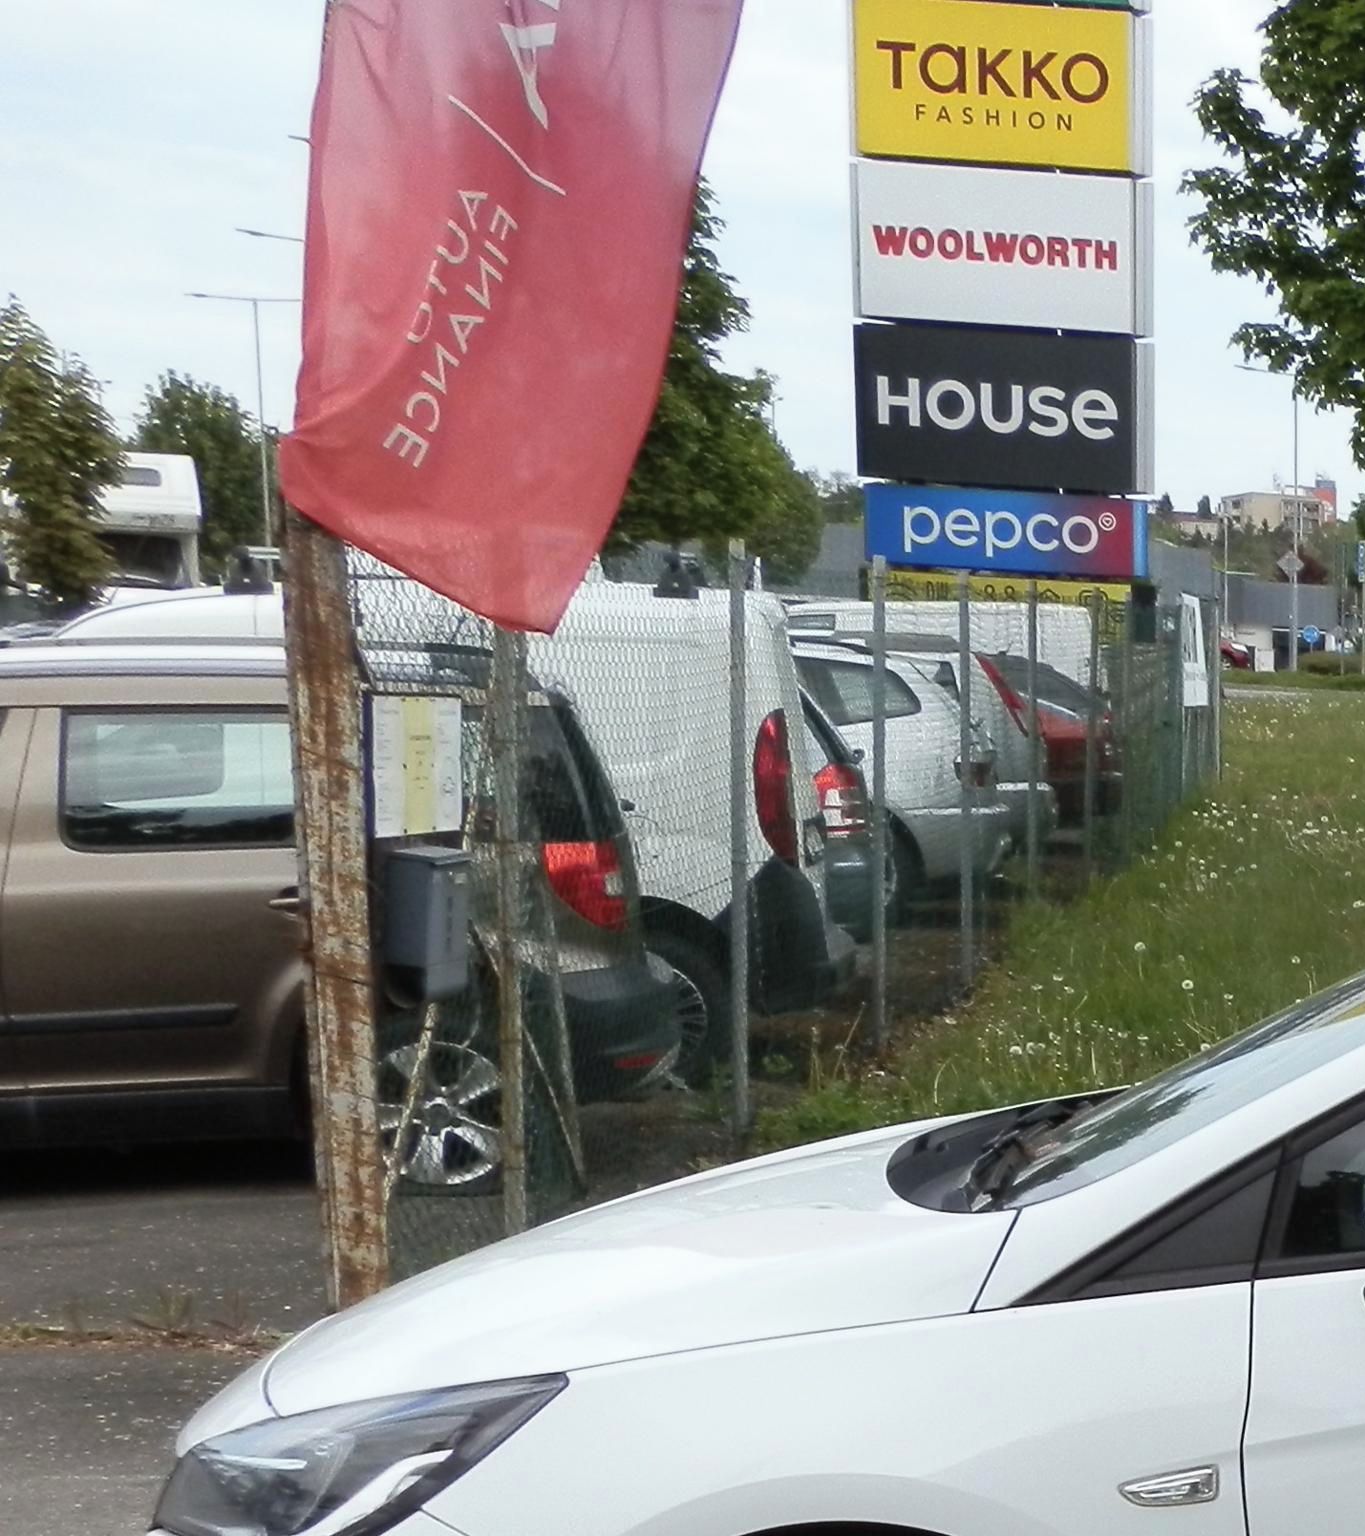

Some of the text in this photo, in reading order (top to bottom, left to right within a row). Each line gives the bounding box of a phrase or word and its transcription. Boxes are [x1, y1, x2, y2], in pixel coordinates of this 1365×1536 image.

[914, 103, 1074, 132] FASHION
[872, 224, 1119, 271] WOOLWORTH
[903, 504, 1099, 558] pepco
